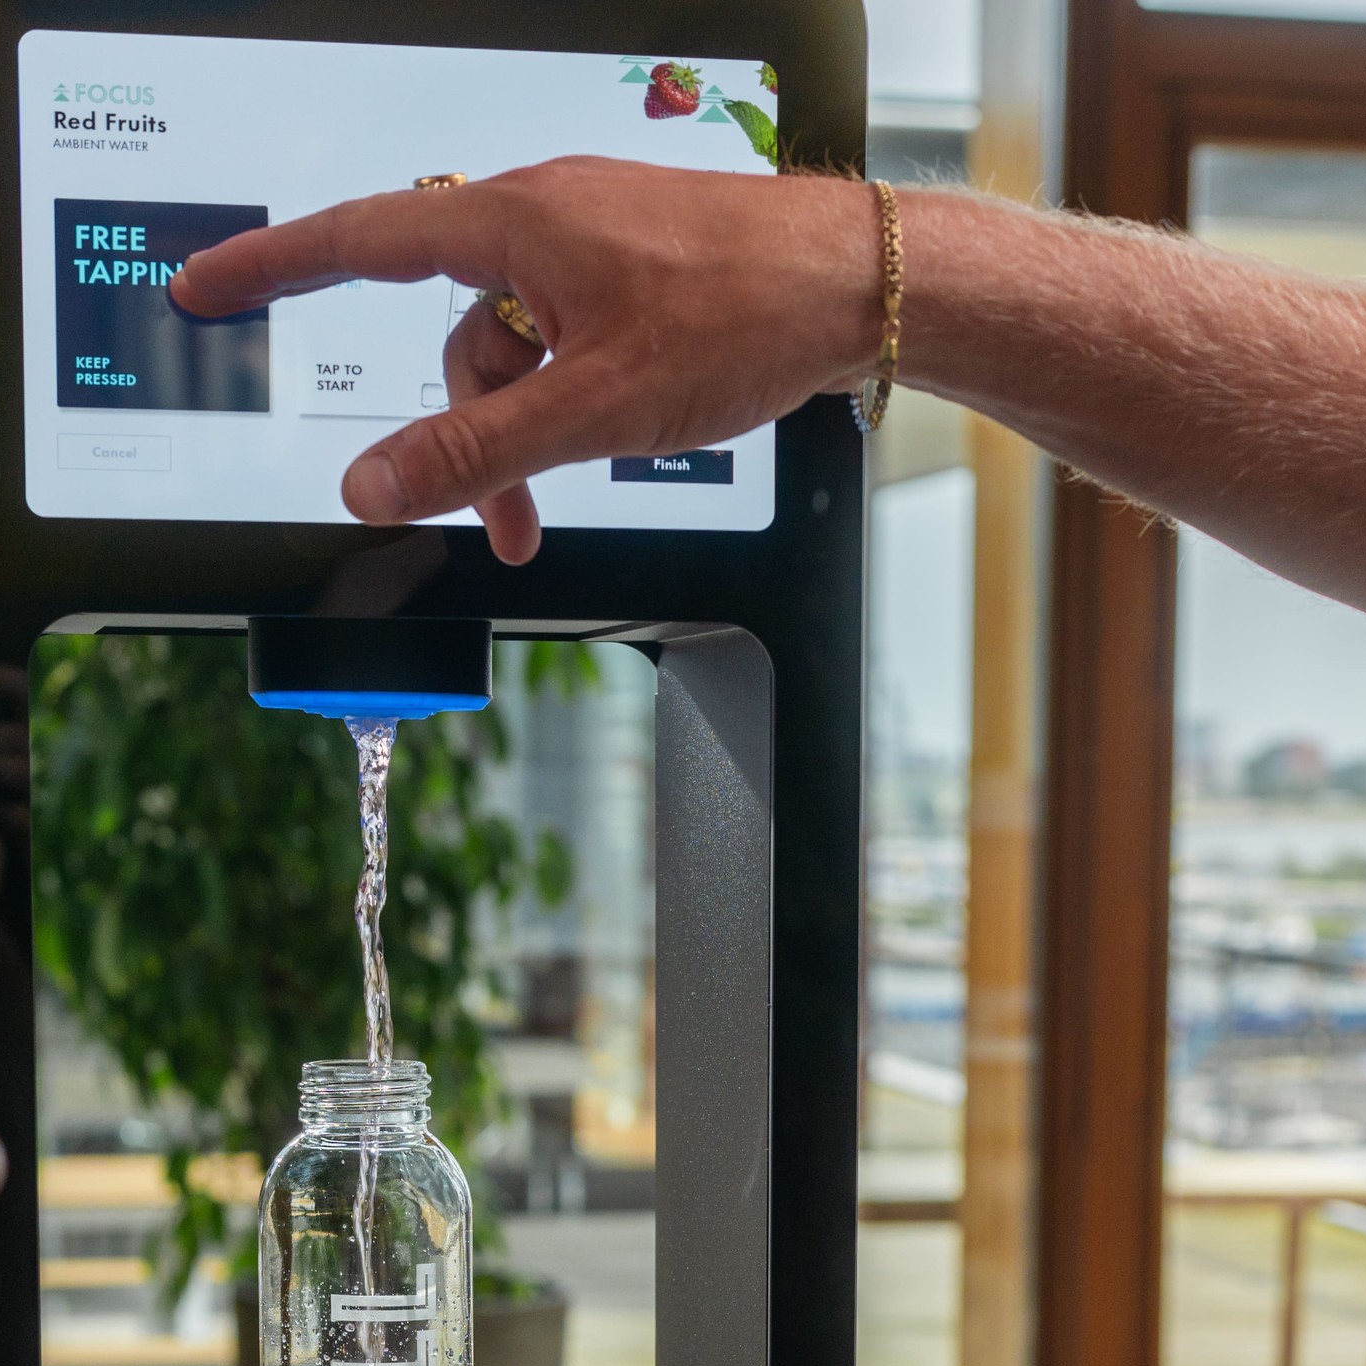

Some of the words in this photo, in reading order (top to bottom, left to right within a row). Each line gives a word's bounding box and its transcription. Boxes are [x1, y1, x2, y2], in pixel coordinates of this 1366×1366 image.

[74, 83, 155, 106] FOCUS
[54, 110, 96, 130] Red
[106, 113, 167, 133] Fruits
[52, 138, 107, 150] AMBIENT
[108, 140, 149, 152] WATER
[75, 224, 146, 251] FREE
[73, 259, 185, 287] TAPPIN
[75, 356, 110, 370] KEEP
[316, 363, 340, 376] TAP
[343, 364, 363, 376] TO
[75, 373, 137, 387] PRESSED
[317, 380, 356, 392] START
[91, 446, 137, 459] Cancel
[654, 458, 691, 471] Finish
